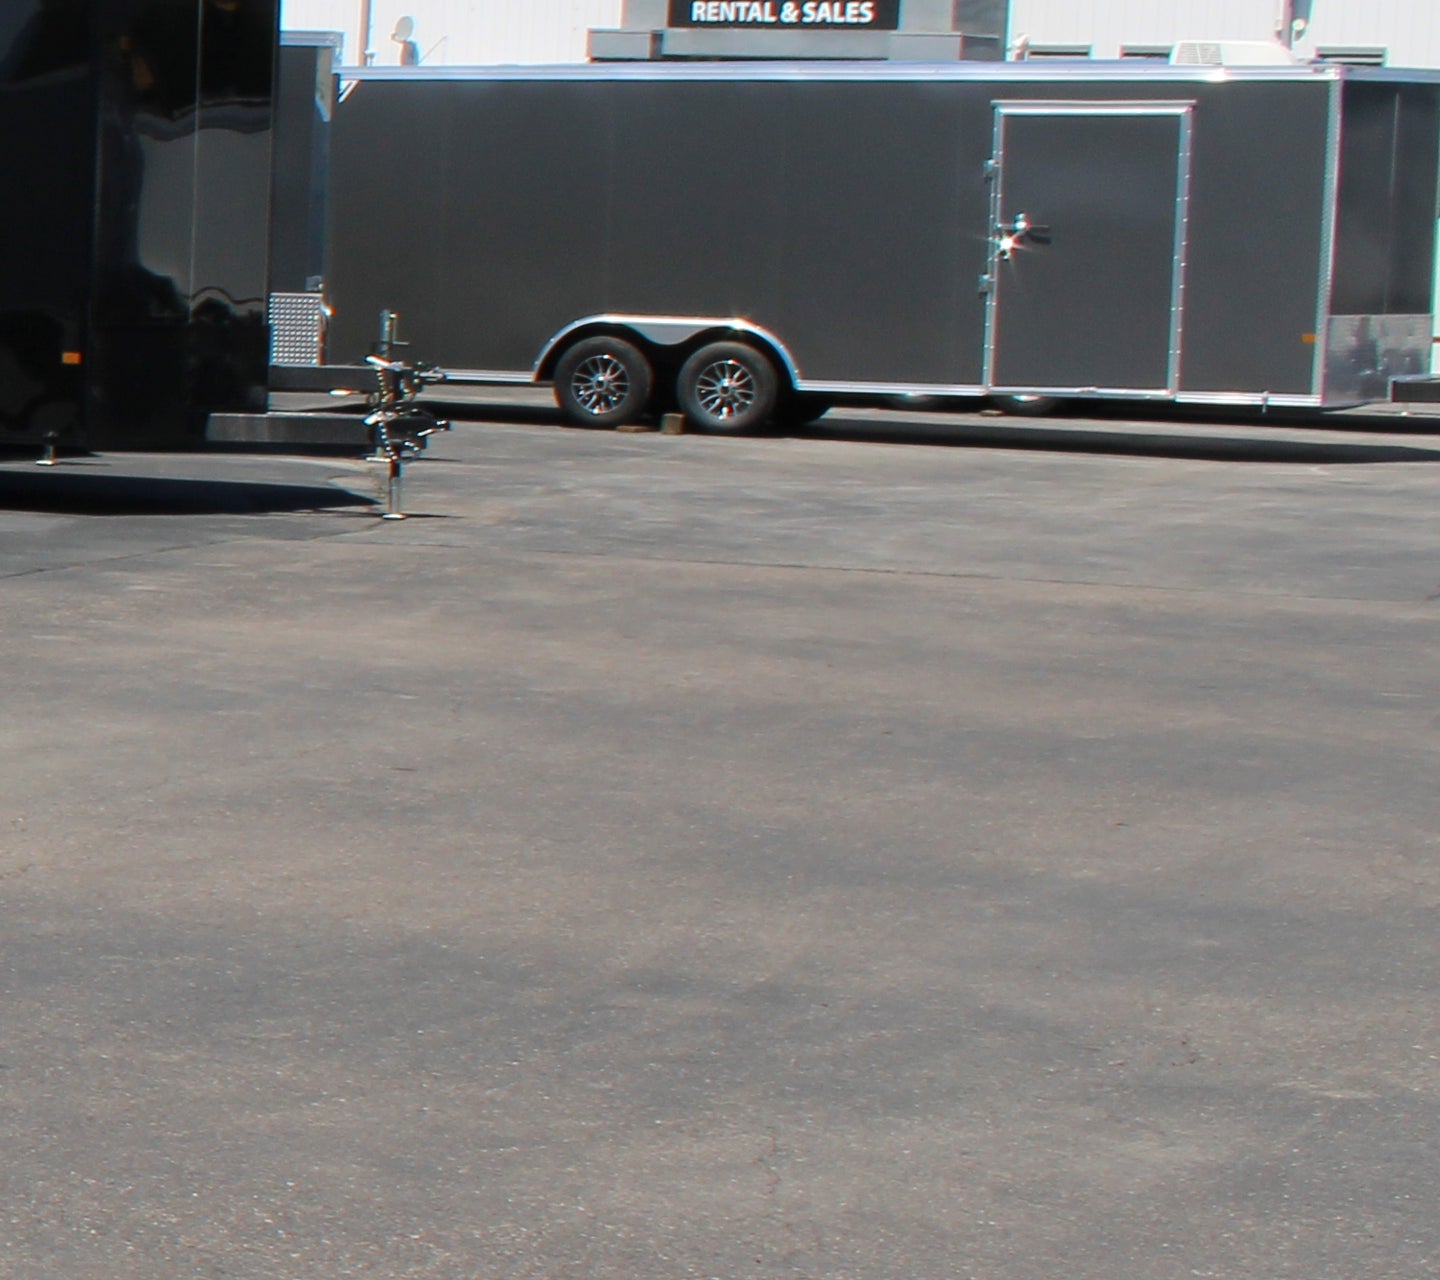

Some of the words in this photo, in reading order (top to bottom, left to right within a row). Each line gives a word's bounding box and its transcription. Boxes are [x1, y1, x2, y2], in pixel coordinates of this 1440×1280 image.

[691, 0, 777, 23] RENTAL
[780, 1, 801, 23] &
[802, 1, 875, 24] SALES
